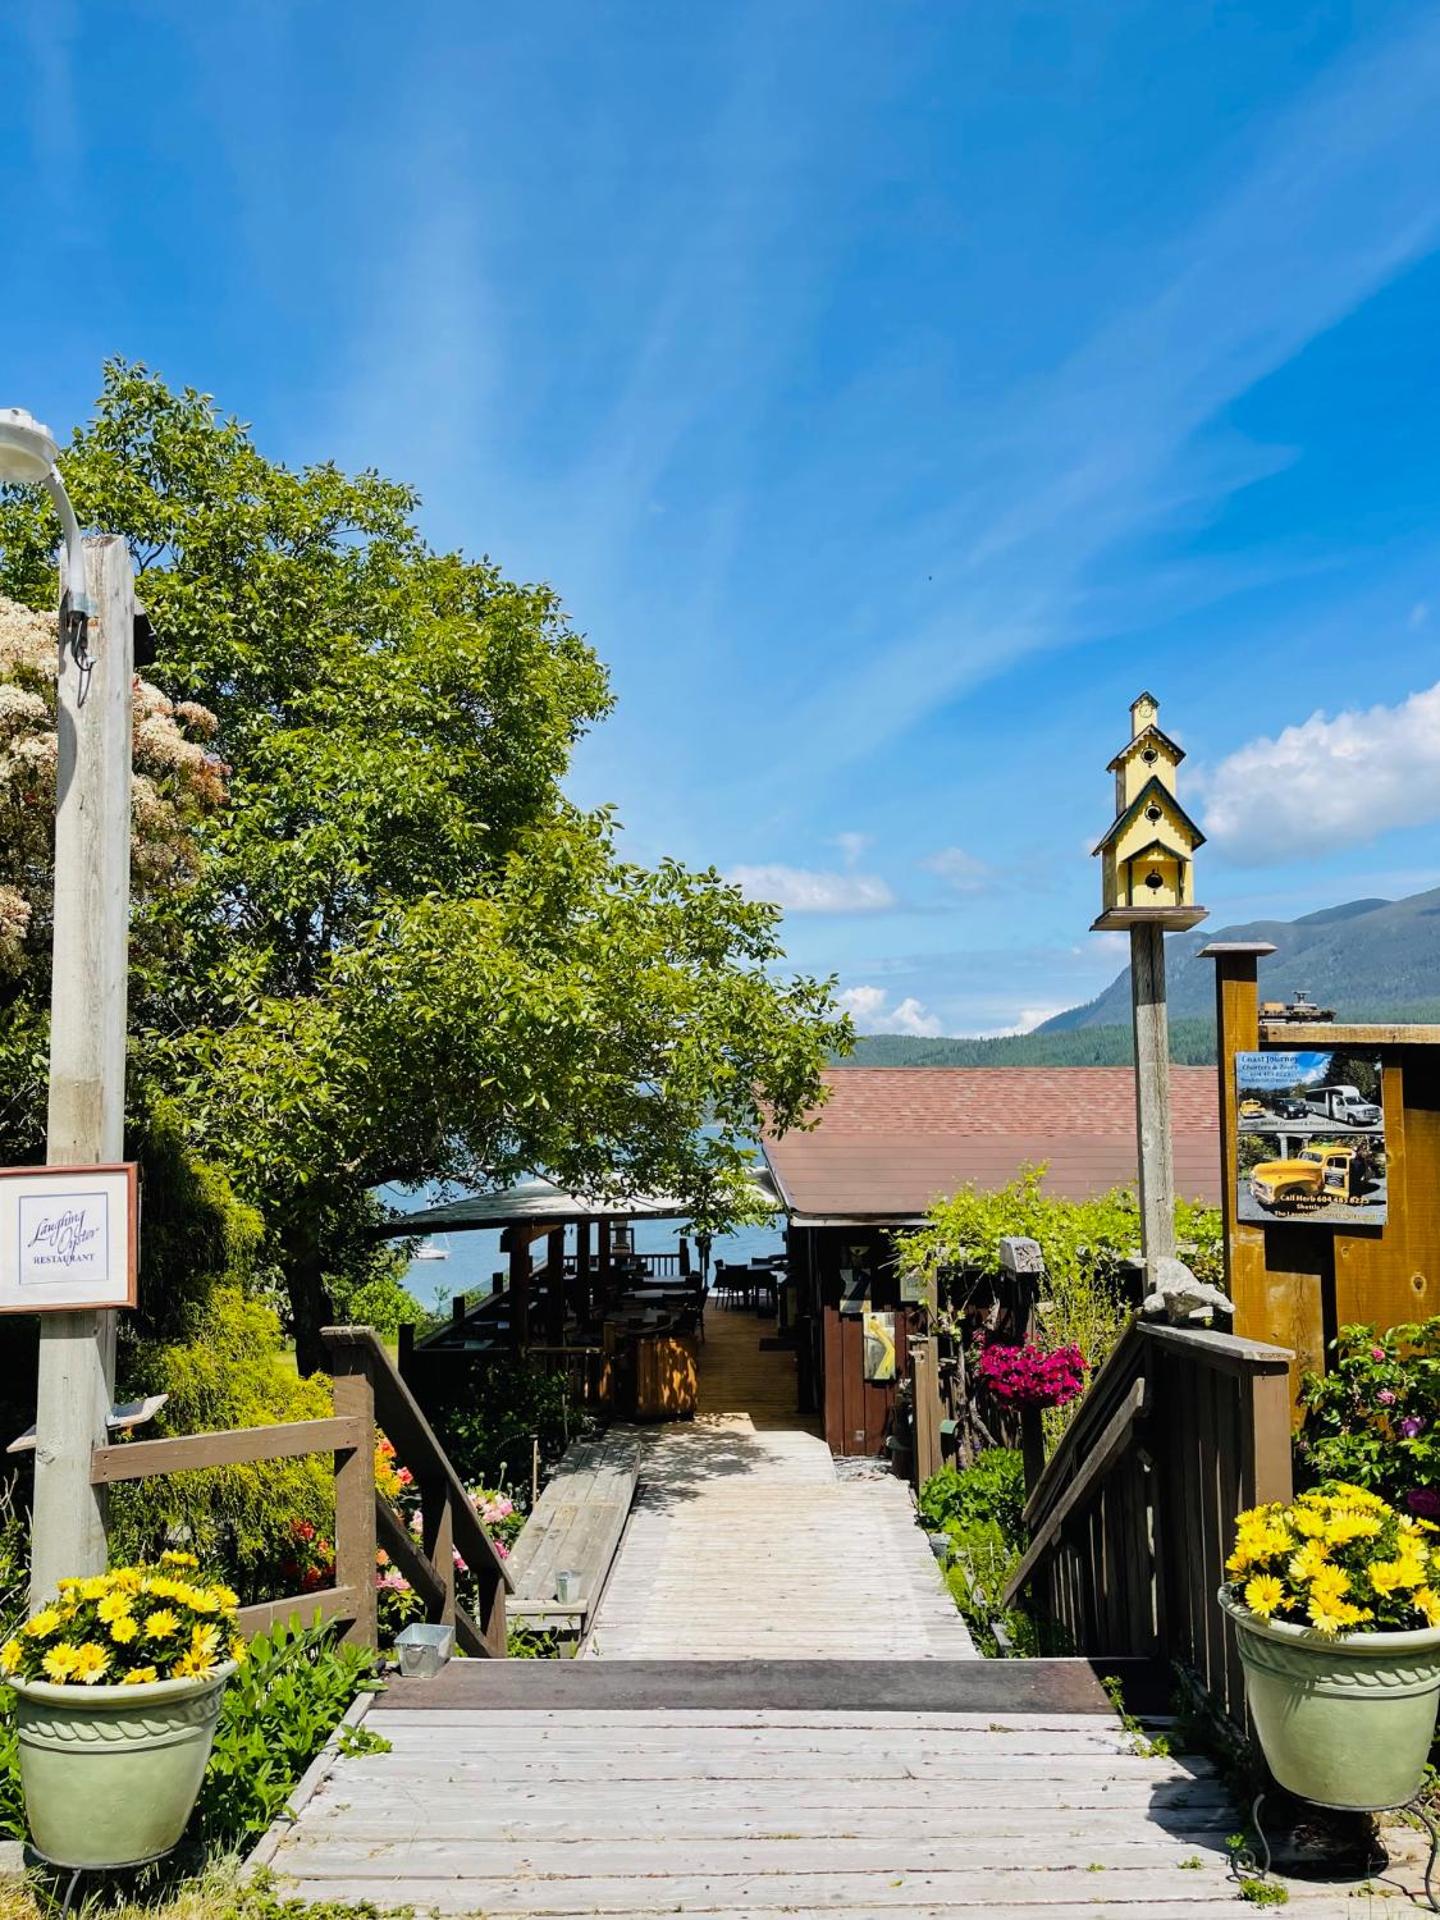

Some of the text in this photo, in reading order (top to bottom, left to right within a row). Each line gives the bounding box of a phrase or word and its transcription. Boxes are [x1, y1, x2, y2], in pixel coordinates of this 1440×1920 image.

[27, 1209, 86, 1248] Laughing
[58, 1225, 100, 1266] Oyster
[33, 1253, 95, 1265] RESTAURANT
